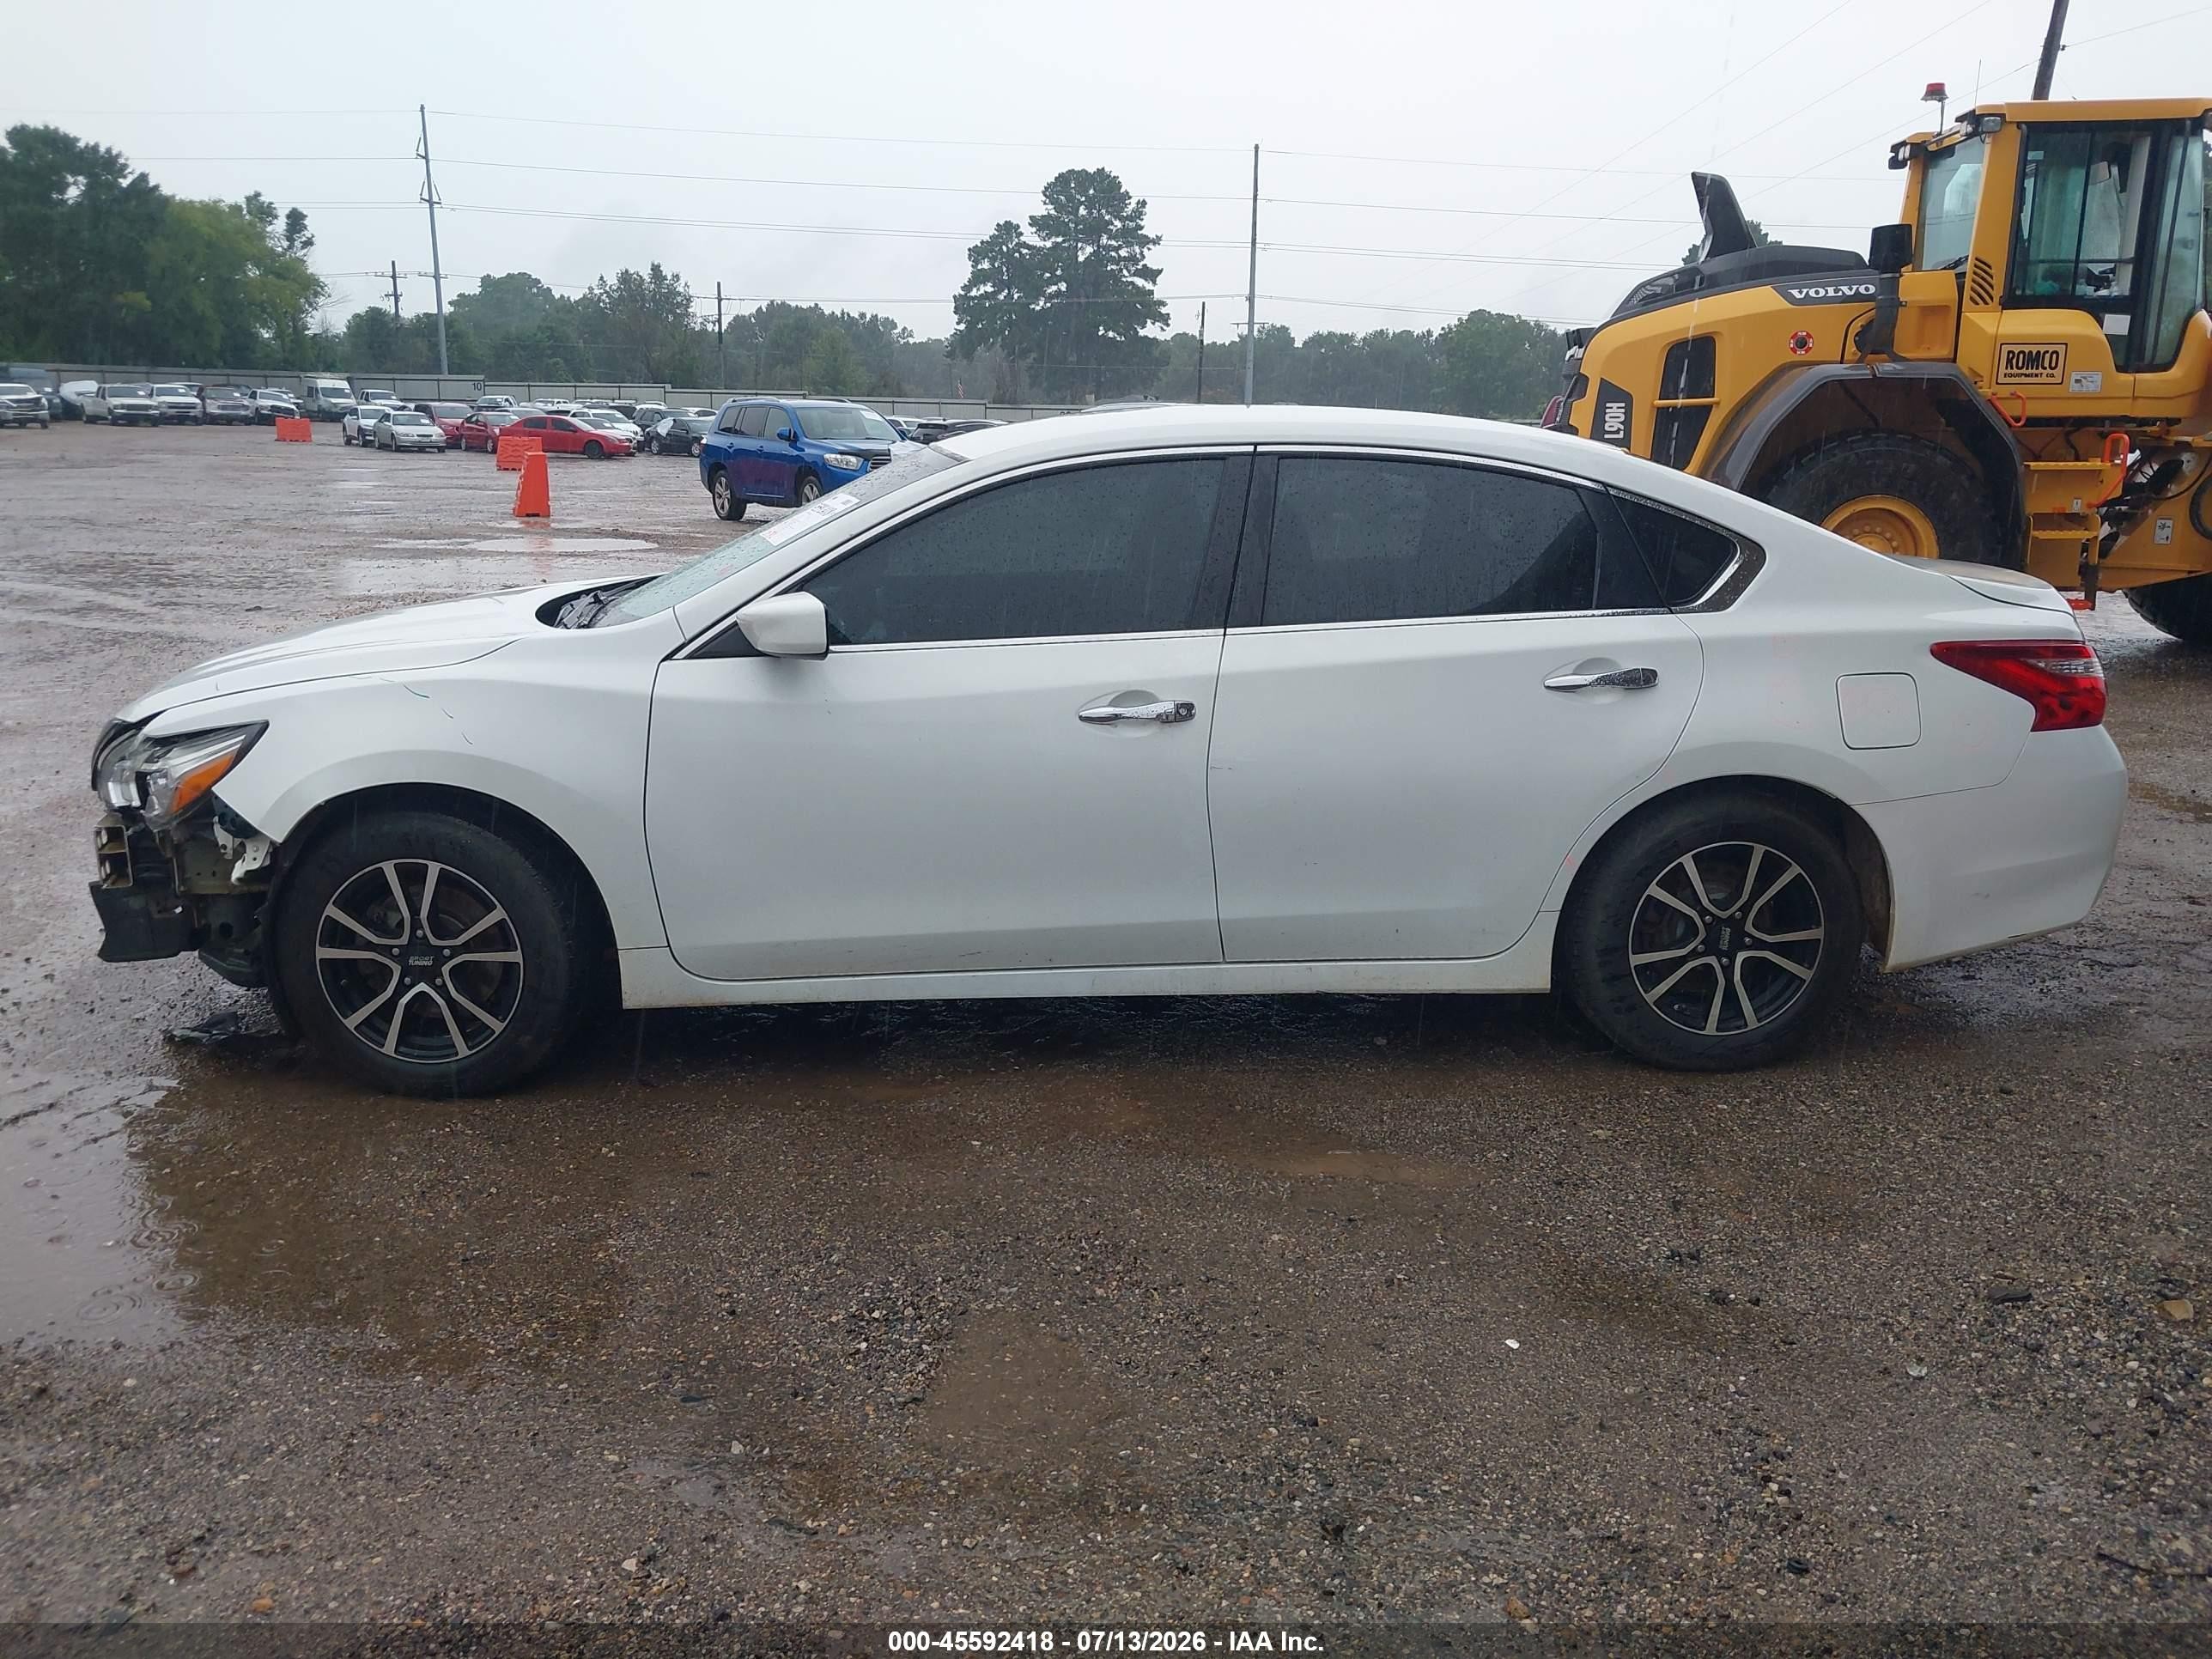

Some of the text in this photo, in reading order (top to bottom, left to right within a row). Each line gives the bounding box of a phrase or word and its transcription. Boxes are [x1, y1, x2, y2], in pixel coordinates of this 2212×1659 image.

[1788, 284, 1876, 299] VOLVO
[2005, 349, 2060, 370] ROMCO
[471, 382, 482, 392] 10
[1604, 403, 1626, 439] L90H
